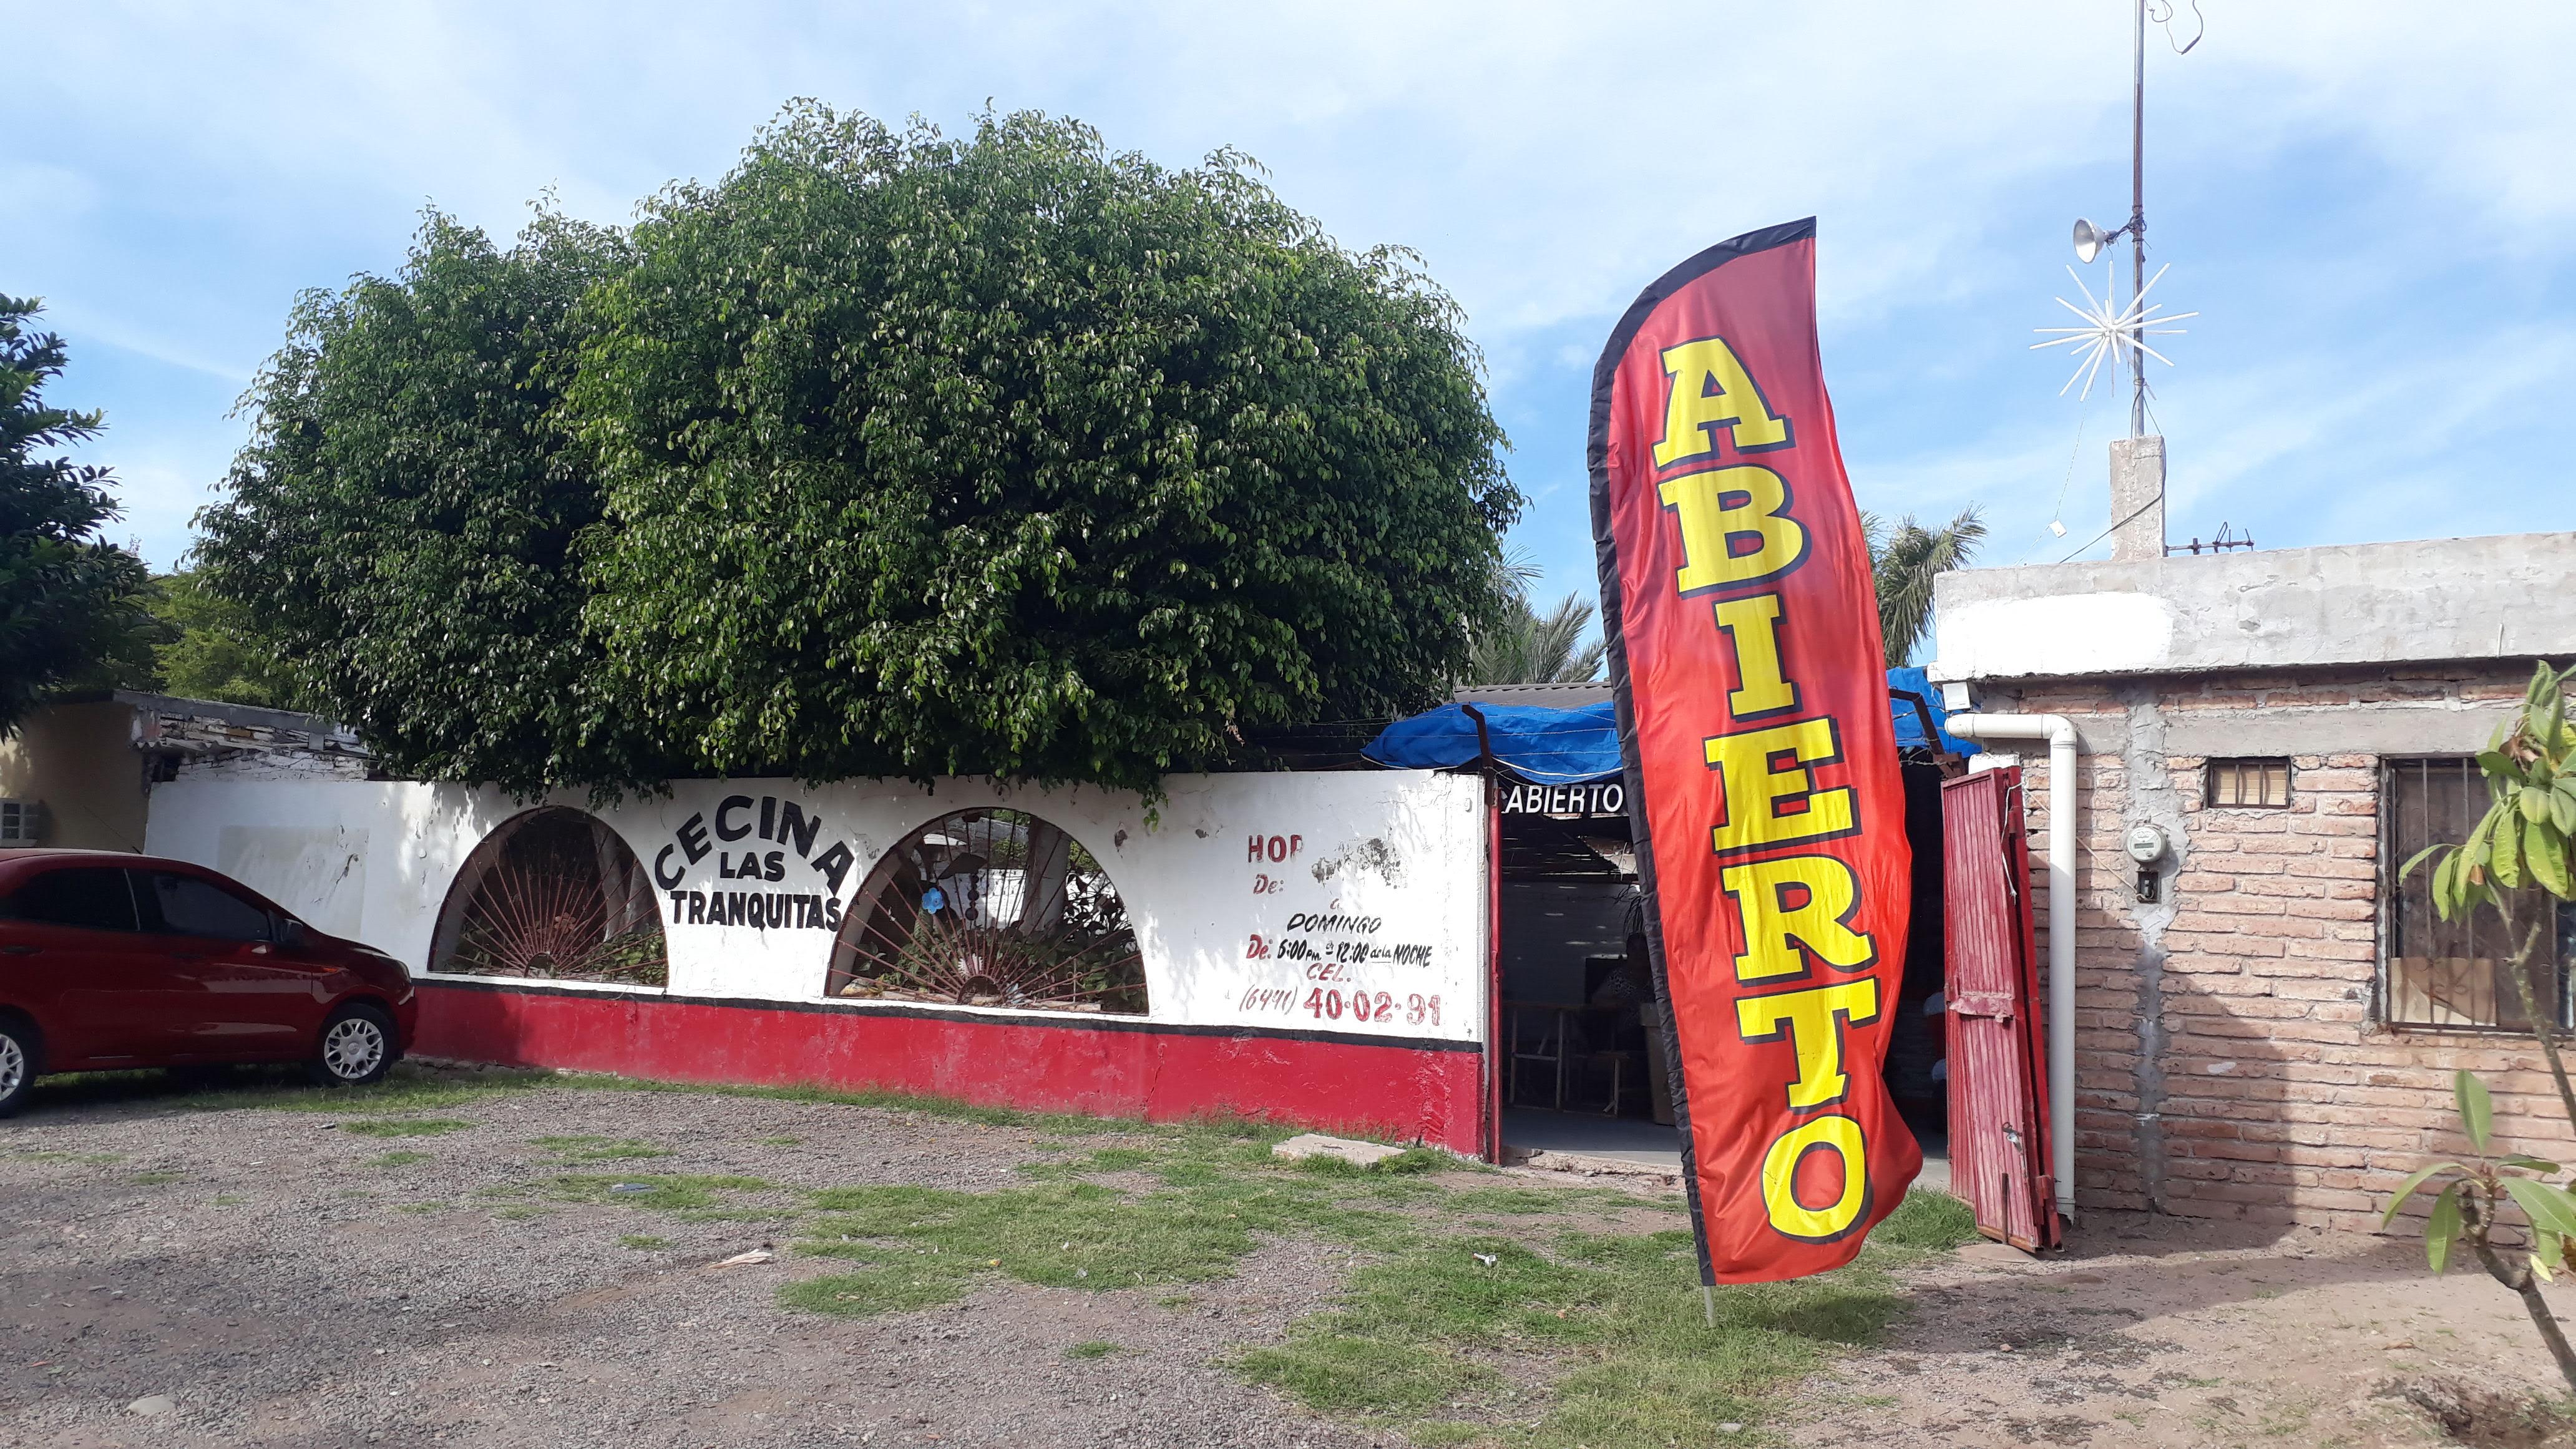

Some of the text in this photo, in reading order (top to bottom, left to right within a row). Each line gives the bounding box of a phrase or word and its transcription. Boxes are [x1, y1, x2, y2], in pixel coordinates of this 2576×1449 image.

[1505, 784, 1623, 814] ABIERTO
[1652, 336, 1879, 1243] ABIERTO
[655, 795, 855, 897] CECINA
[720, 851, 785, 882] LAS
[670, 890, 842, 932] TRANQUITAS
[1287, 913, 1382, 935] DOMINGO
[1246, 934, 1273, 960] De:
[1337, 941, 1370, 964] 12:00
[1393, 944, 1433, 968] NOCHE
[1307, 962, 1352, 982] CEL.
